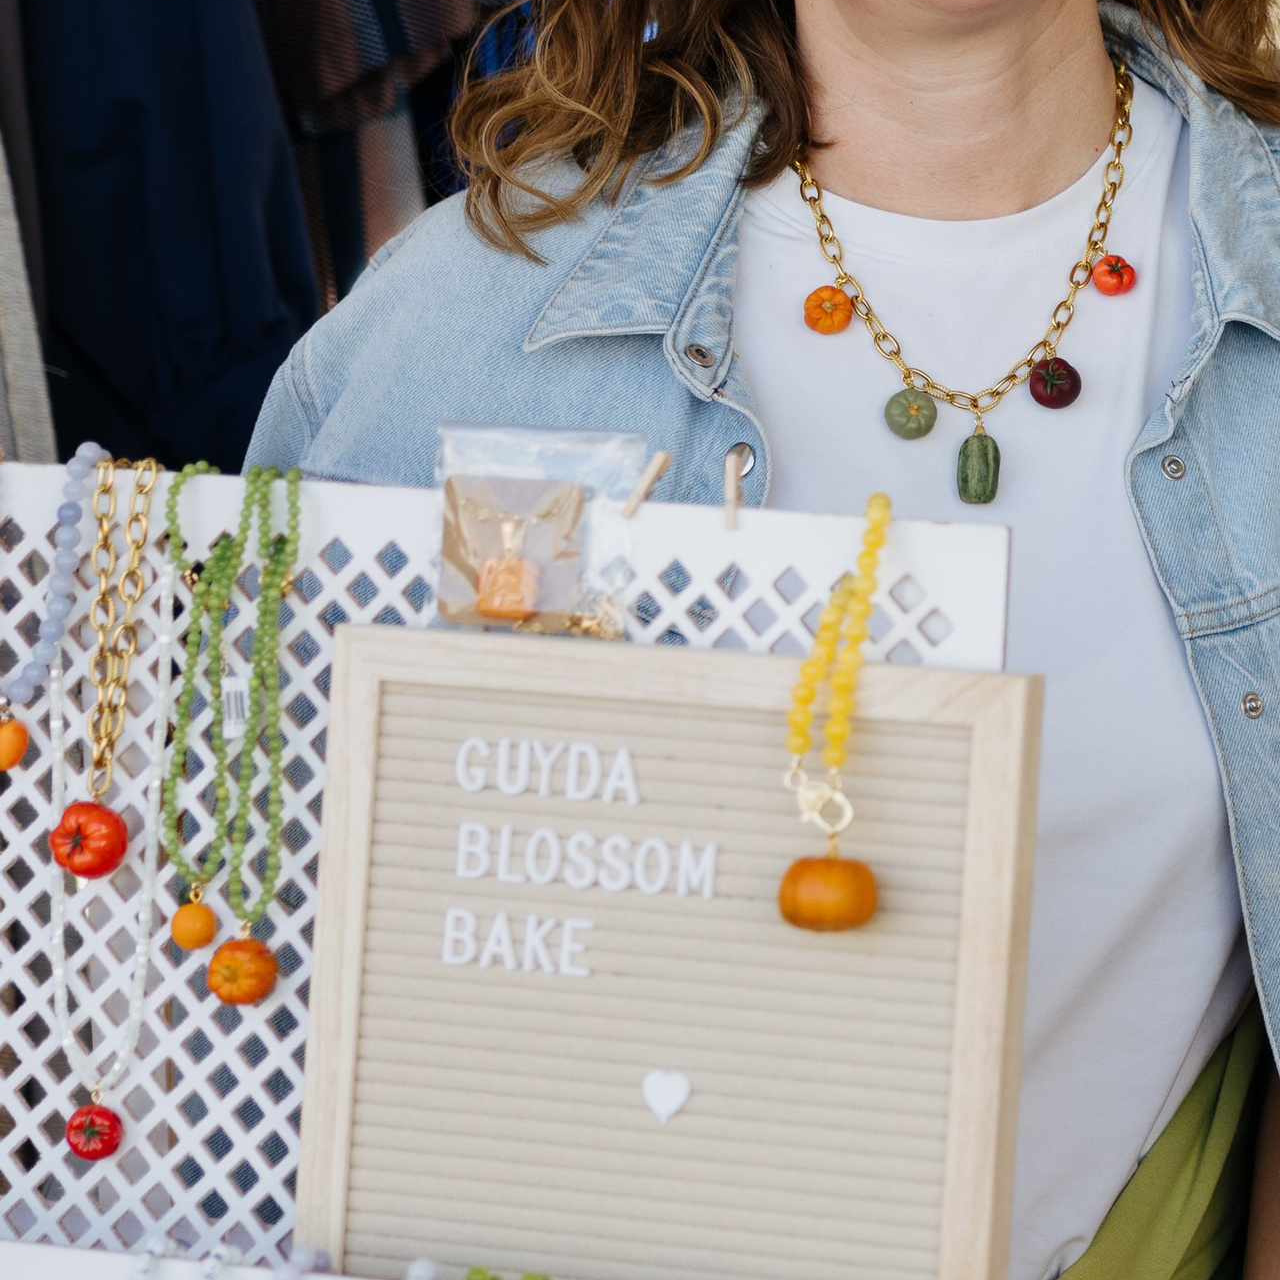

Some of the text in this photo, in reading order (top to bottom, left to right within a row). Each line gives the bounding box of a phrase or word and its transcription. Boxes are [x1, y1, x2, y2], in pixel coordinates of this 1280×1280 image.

[454, 735, 641, 806] GUYDA
[454, 820, 717, 901] BLOSSOM
[440, 906, 596, 978] BAKE
